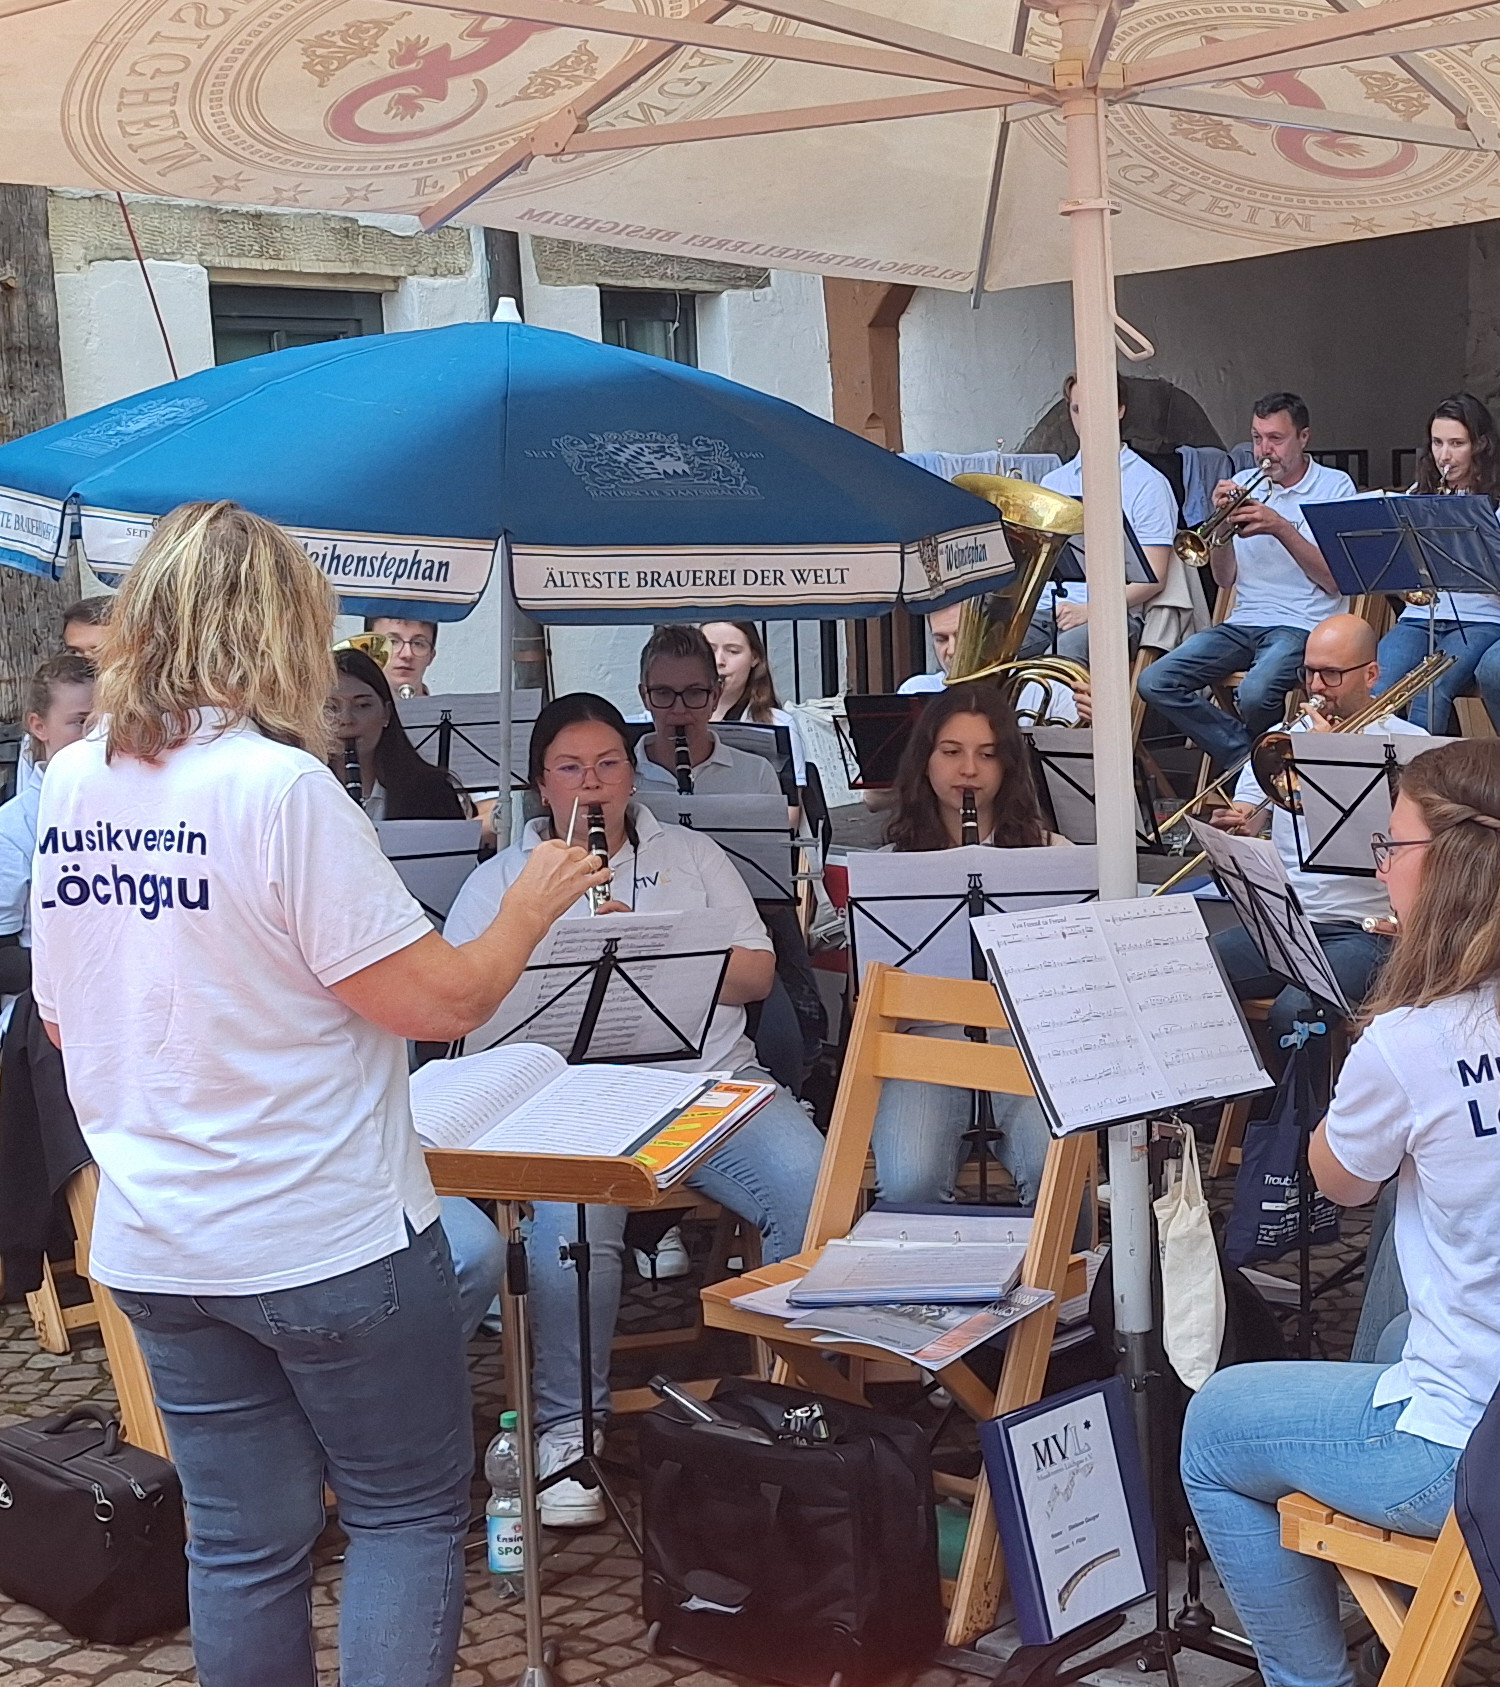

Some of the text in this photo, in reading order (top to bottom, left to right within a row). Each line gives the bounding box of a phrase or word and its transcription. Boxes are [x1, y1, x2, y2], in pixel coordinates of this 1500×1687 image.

[303, 542, 450, 586] eihenstephan
[542, 566, 850, 589] ÄLTESTE BRAUEREI DER WELT
[1031, 1422, 1092, 1473] MVL
